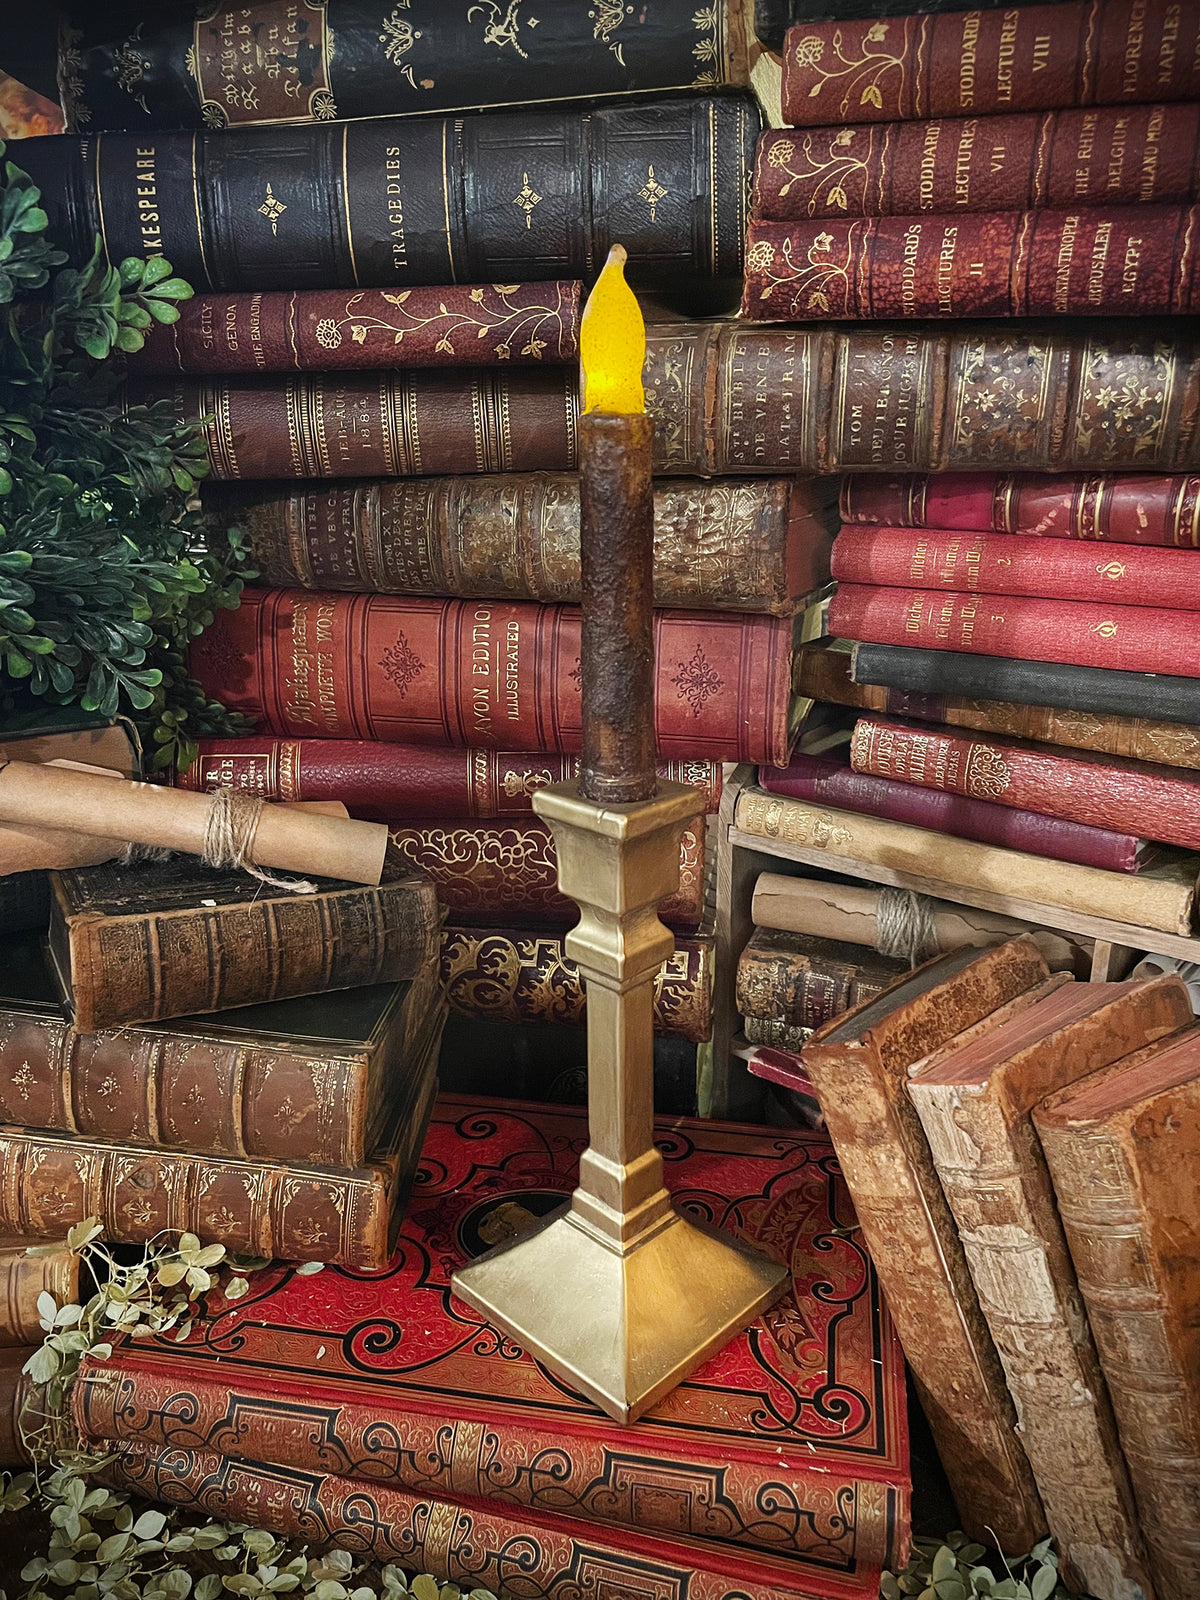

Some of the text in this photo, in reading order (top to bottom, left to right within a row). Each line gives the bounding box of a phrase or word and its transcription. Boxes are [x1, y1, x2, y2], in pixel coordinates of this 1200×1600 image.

[220, 12, 239, 107] Wilhelm
[239, 9, 260, 110] Raabe
[264, 25, 280, 79] Abu
[960, 10, 981, 108] STODDARD'S
[997, 10, 1020, 101] LECTURES
[1032, 36, 1050, 72] VIII
[1158, 4, 1181, 84] NAPLES
[920, 118, 942, 210] STODDARD'S
[956, 119, 979, 205] LECTURES
[990, 146, 1005, 174] VII
[1075, 113, 1099, 195] THE RHINE
[1107, 118, 1129, 190] BELGIUM
[137, 147, 164, 260] AKESPEARE
[386, 147, 408, 269] TRAGEDIES
[902, 224, 921, 315] STODDARD'S
[938, 226, 958, 313] LECTURES
[970, 262, 984, 276] II
[1055, 215, 1080, 313] CONSTANTINOPLE
[1089, 221, 1112, 306] JERUSALEM
[1122, 237, 1143, 294] EGYPT
[201, 303, 214, 349] SICILY
[226, 303, 239, 351] GENOA
[249, 293, 266, 369] THE ENGADIN
[732, 345, 748, 421] BIBLE
[755, 345, 771, 458] DE VENCE
[850, 404, 864, 447] TOM
[997, 557, 1011, 566] 2
[506, 621, 520, 721] ILLUSTRATED
[472, 687, 498, 740] AVON
[877, 729, 896, 776] LOUISE
[947, 750, 961, 787] DUMAS
